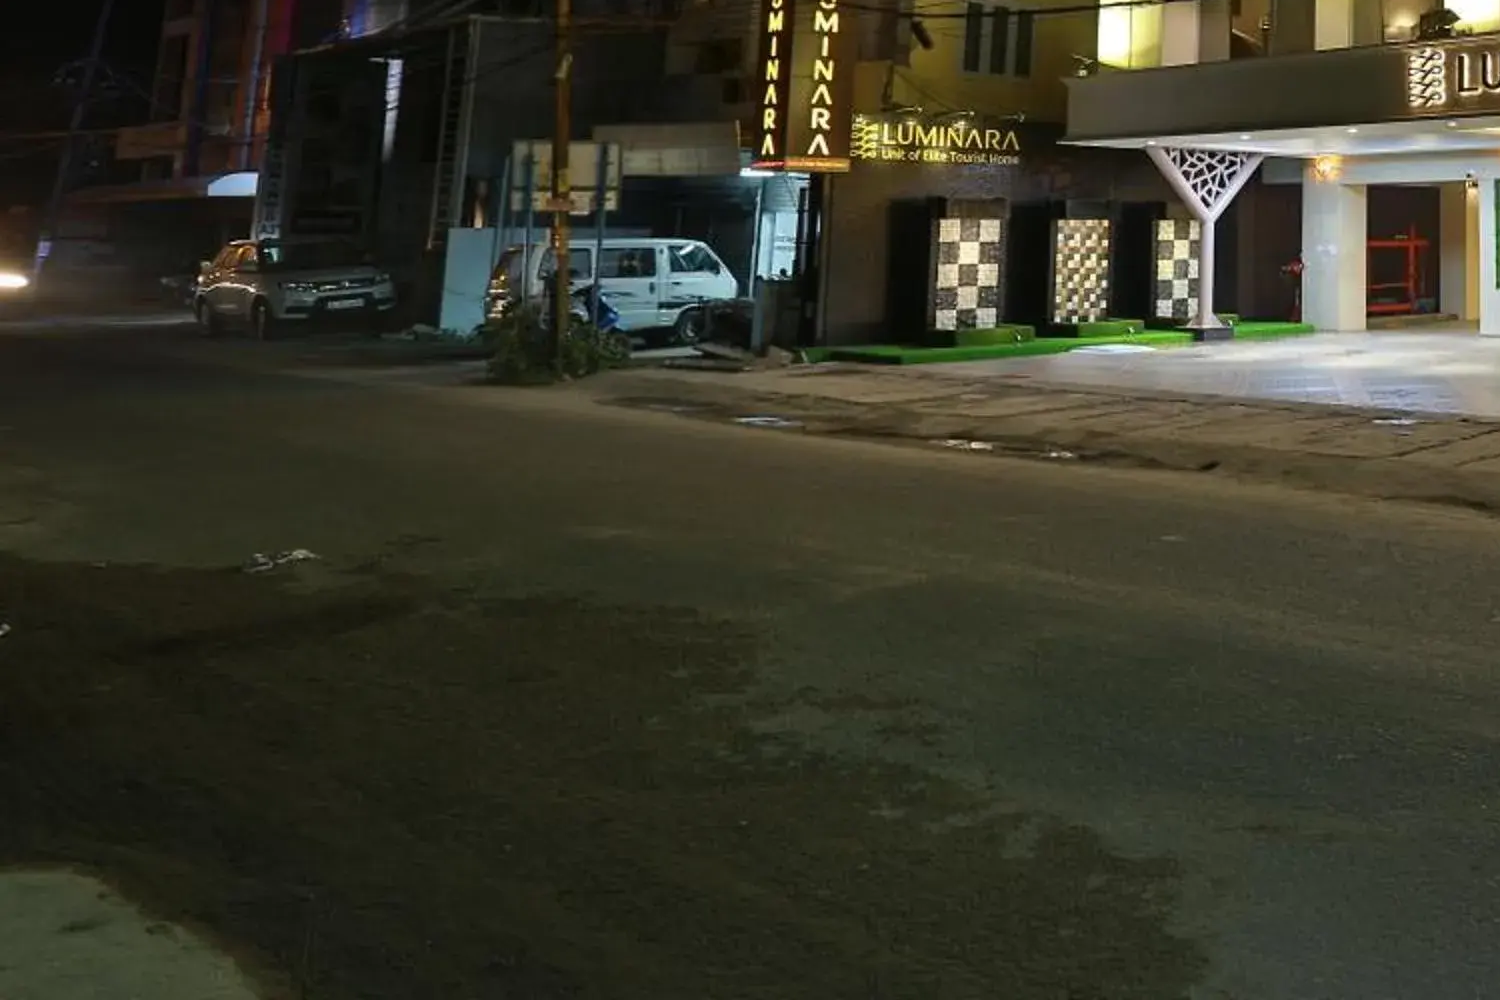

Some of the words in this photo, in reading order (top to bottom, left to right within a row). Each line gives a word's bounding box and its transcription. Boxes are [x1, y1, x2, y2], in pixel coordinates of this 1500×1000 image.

[883, 122, 1020, 151] LUMINARA
[907, 150, 920, 161] of
[989, 152, 1020, 165] Home
